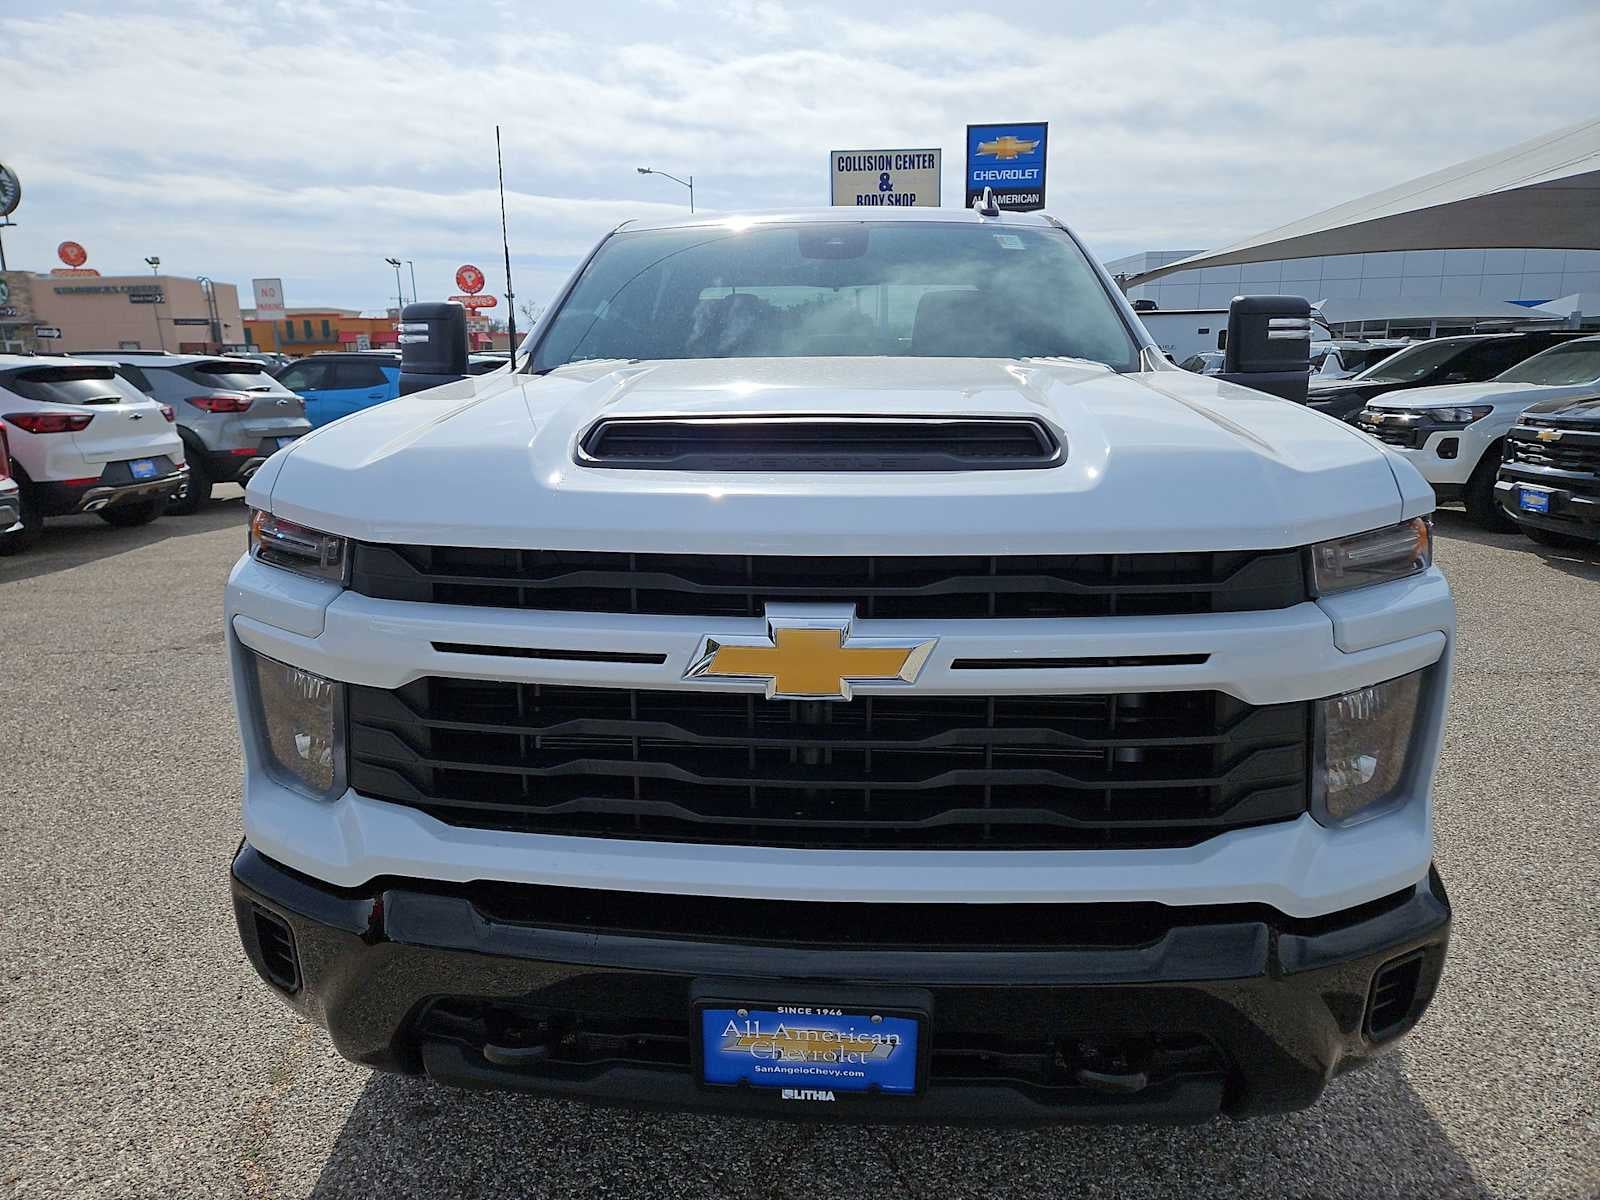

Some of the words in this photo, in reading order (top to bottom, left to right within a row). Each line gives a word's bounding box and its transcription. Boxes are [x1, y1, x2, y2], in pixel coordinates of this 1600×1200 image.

[838, 155, 892, 172] COLLISION
[895, 153, 935, 170] CENTER
[879, 172, 893, 192] &
[973, 169, 1039, 181] CHEVROLET
[261, 287, 276, 297] NO
[777, 1006, 812, 1015] SINCE
[816, 1007, 843, 1016] 1946
[721, 1019, 761, 1039] All
[772, 1023, 902, 1046] American
[749, 1041, 867, 1065] Chevrolet
[754, 1064, 865, 1078] SanAngeloChevy.com
[793, 1089, 835, 1101] LITHIA
